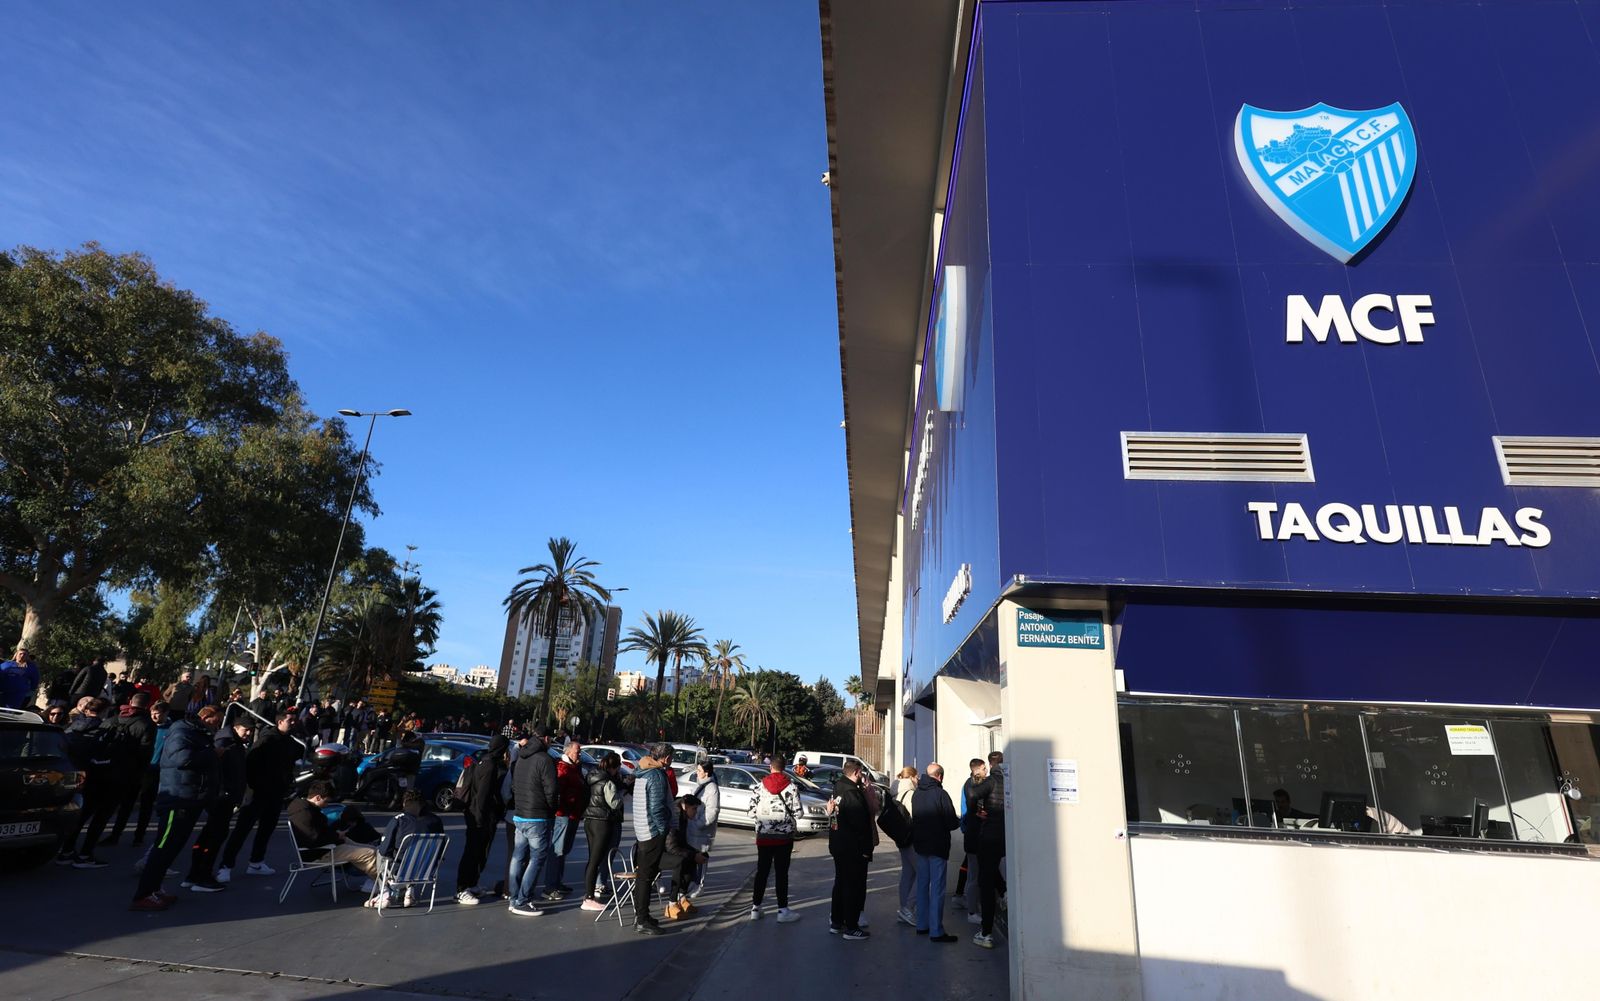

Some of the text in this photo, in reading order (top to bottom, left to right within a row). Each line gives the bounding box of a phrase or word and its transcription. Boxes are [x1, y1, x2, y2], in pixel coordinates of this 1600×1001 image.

[1286, 293, 1435, 344] MCF
[1248, 501, 1552, 549] TAQUILLAS
[1018, 611, 1045, 622] Pasaje
[1019, 622, 1054, 632] ANTONIO
[1019, 632, 1100, 645] FERNÁNDEZ BENÍTEZ
